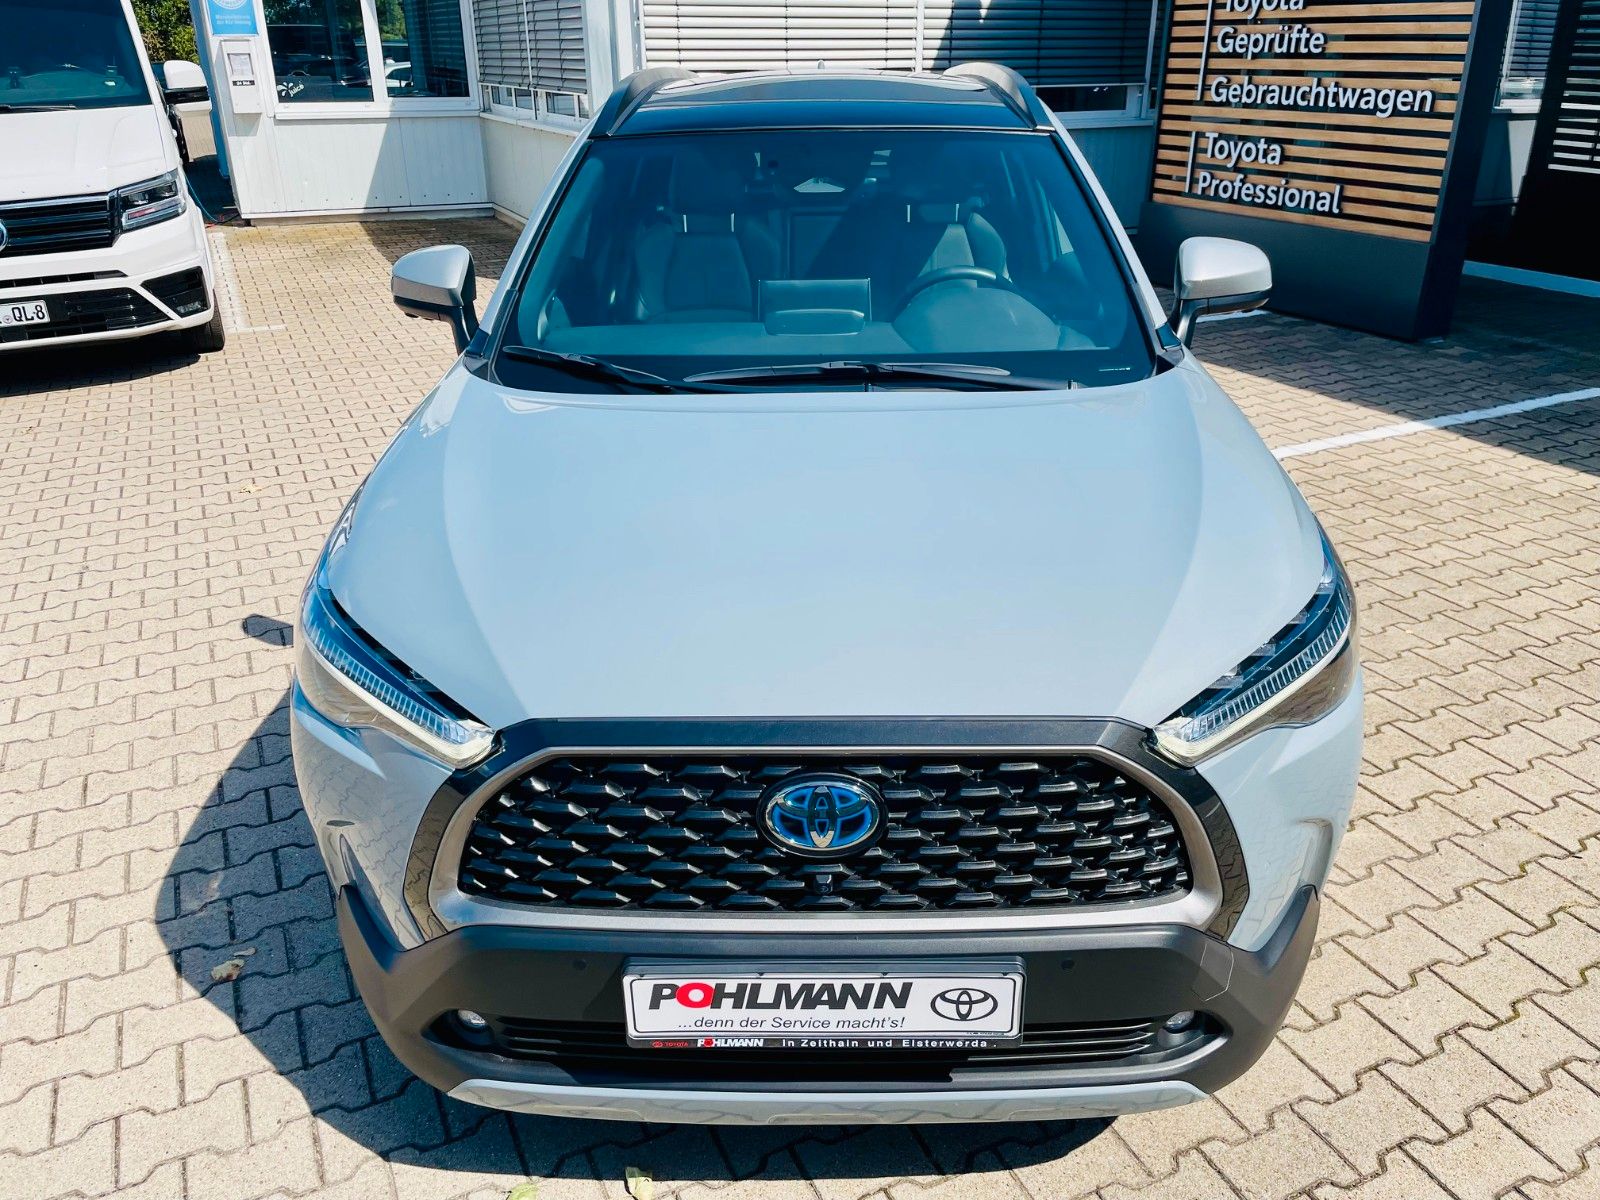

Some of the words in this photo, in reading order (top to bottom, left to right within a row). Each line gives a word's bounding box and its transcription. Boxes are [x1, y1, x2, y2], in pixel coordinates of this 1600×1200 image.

[1217, 24, 1325, 60] Geprüfte
[1210, 76, 1433, 118] Gebrauchtwagen
[1205, 132, 1282, 169] Toyota
[1197, 171, 1342, 214] Professional
[648, 982, 913, 1010] POHLMANN
[739, 1016, 767, 1028] der
[771, 1016, 831, 1029] Service
[836, 1016, 905, 1029] macht's!
[697, 1036, 764, 1048] POHLMANN
[800, 1039, 859, 1048] Zeithain
[867, 1039, 893, 1048] und
